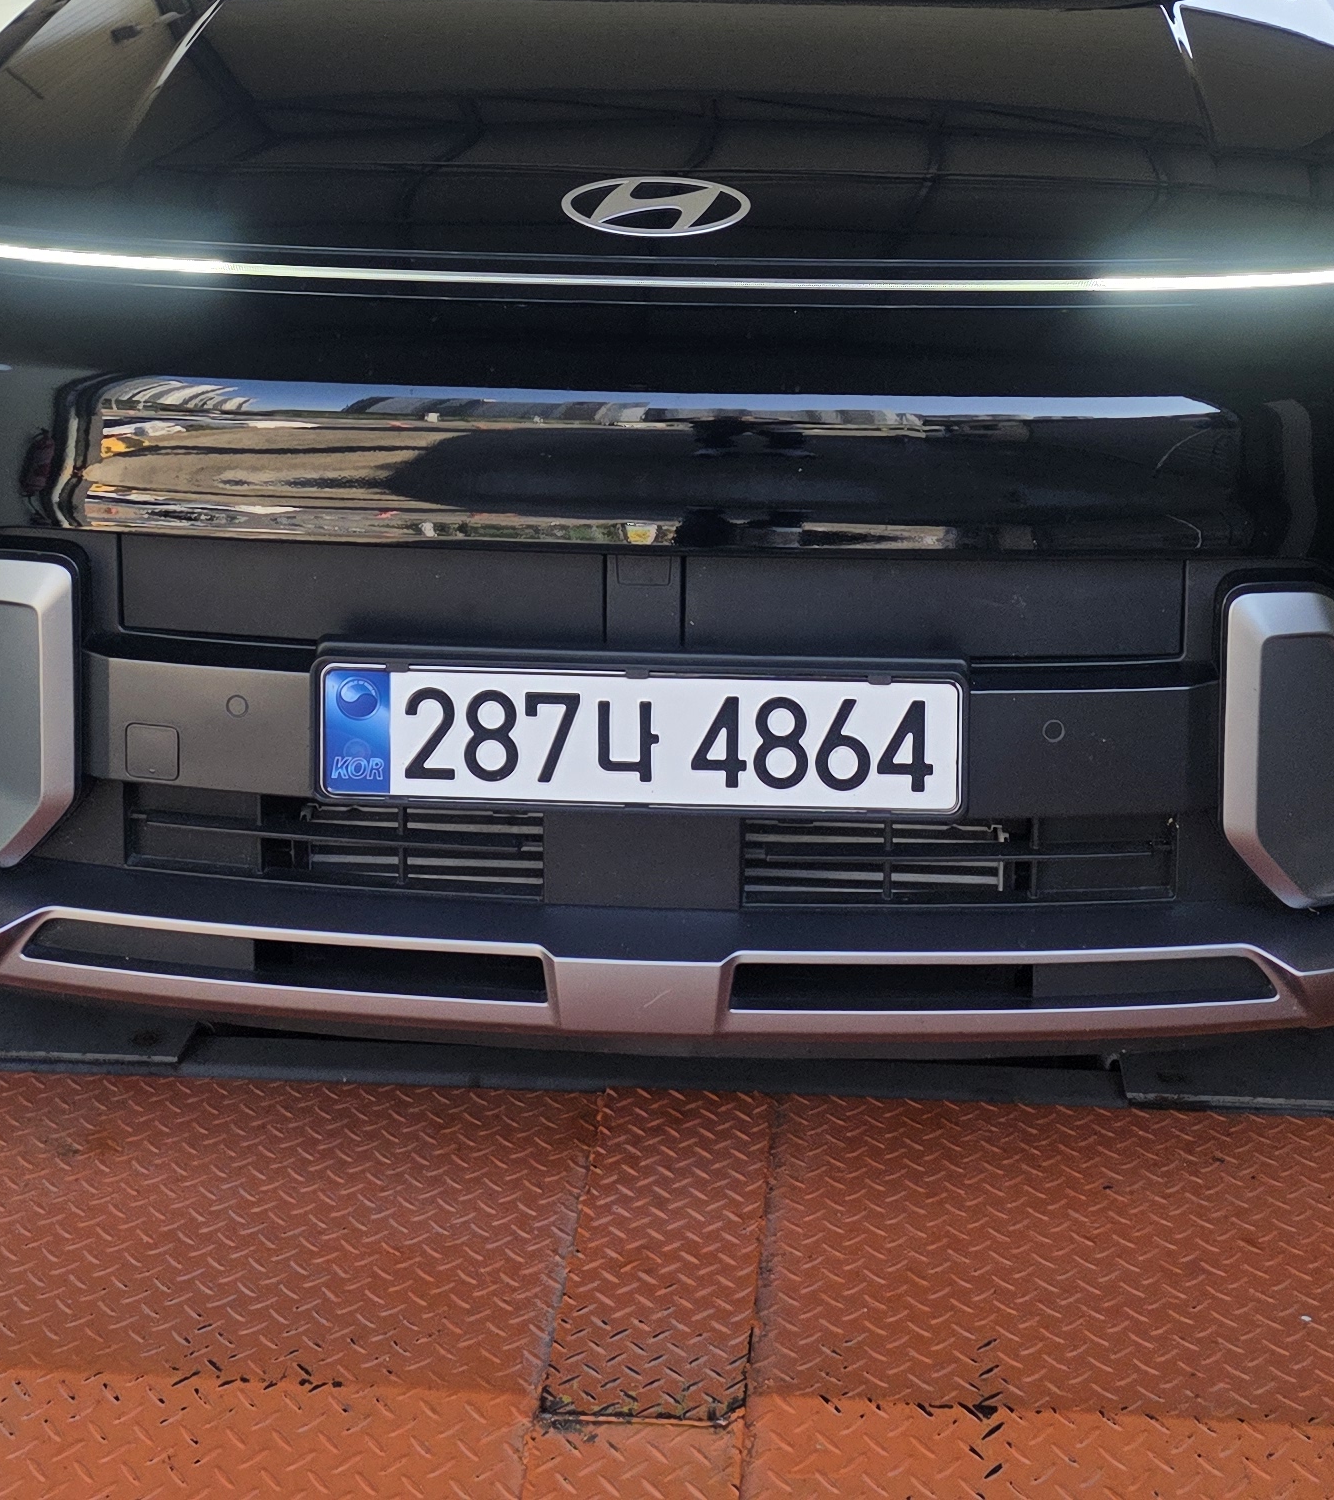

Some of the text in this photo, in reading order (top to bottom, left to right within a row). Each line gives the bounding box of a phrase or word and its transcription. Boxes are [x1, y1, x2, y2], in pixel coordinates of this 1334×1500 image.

[331, 756, 385, 780] KOR
[404, 687, 934, 793] 287나 4864
